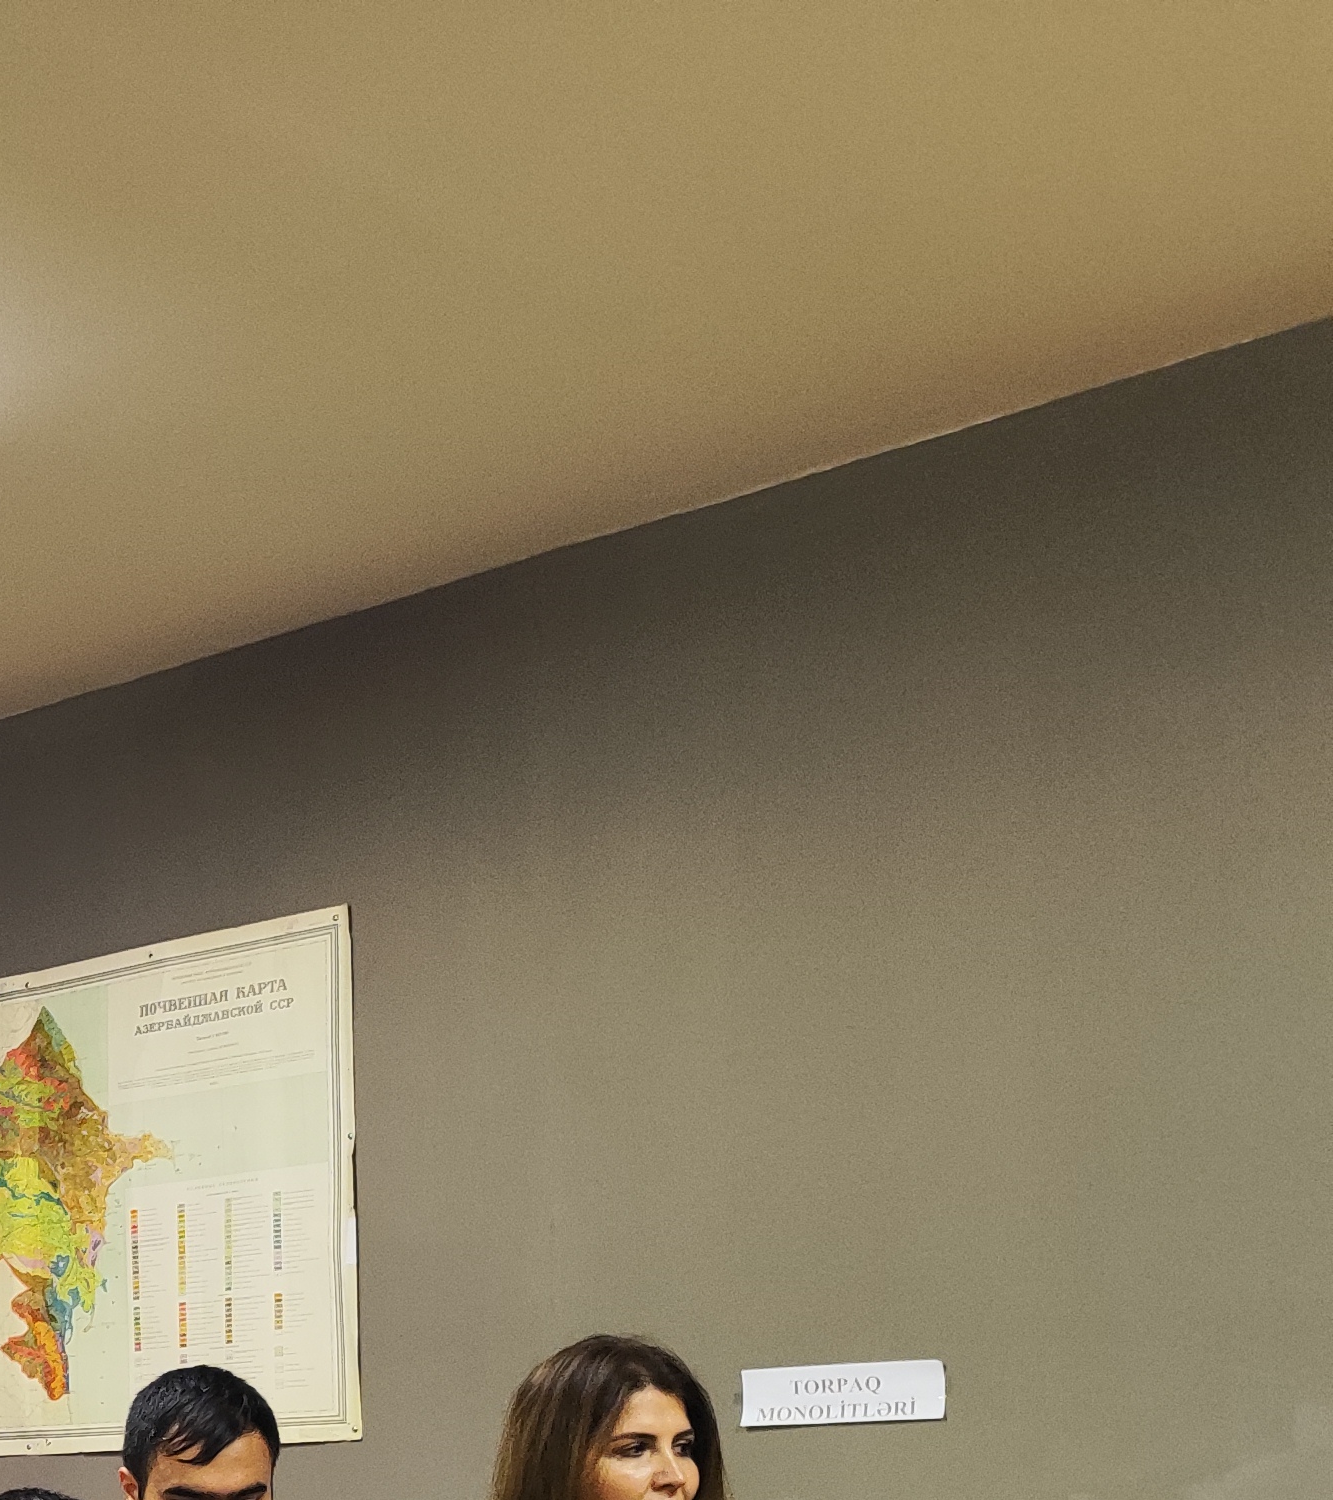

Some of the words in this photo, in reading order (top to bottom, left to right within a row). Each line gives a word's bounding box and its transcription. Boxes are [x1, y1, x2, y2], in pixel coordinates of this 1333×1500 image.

[139, 990, 229, 1018] ПОЧВЕННАЯ
[235, 978, 288, 1000] КАРТА
[134, 1001, 263, 1036] АЗЕРБАЙДЖАНСКОЙ
[269, 997, 295, 1011] ССР
[789, 1376, 882, 1395] TORPAQ
[756, 1397, 917, 1422] MONOLİTLƏRİ
